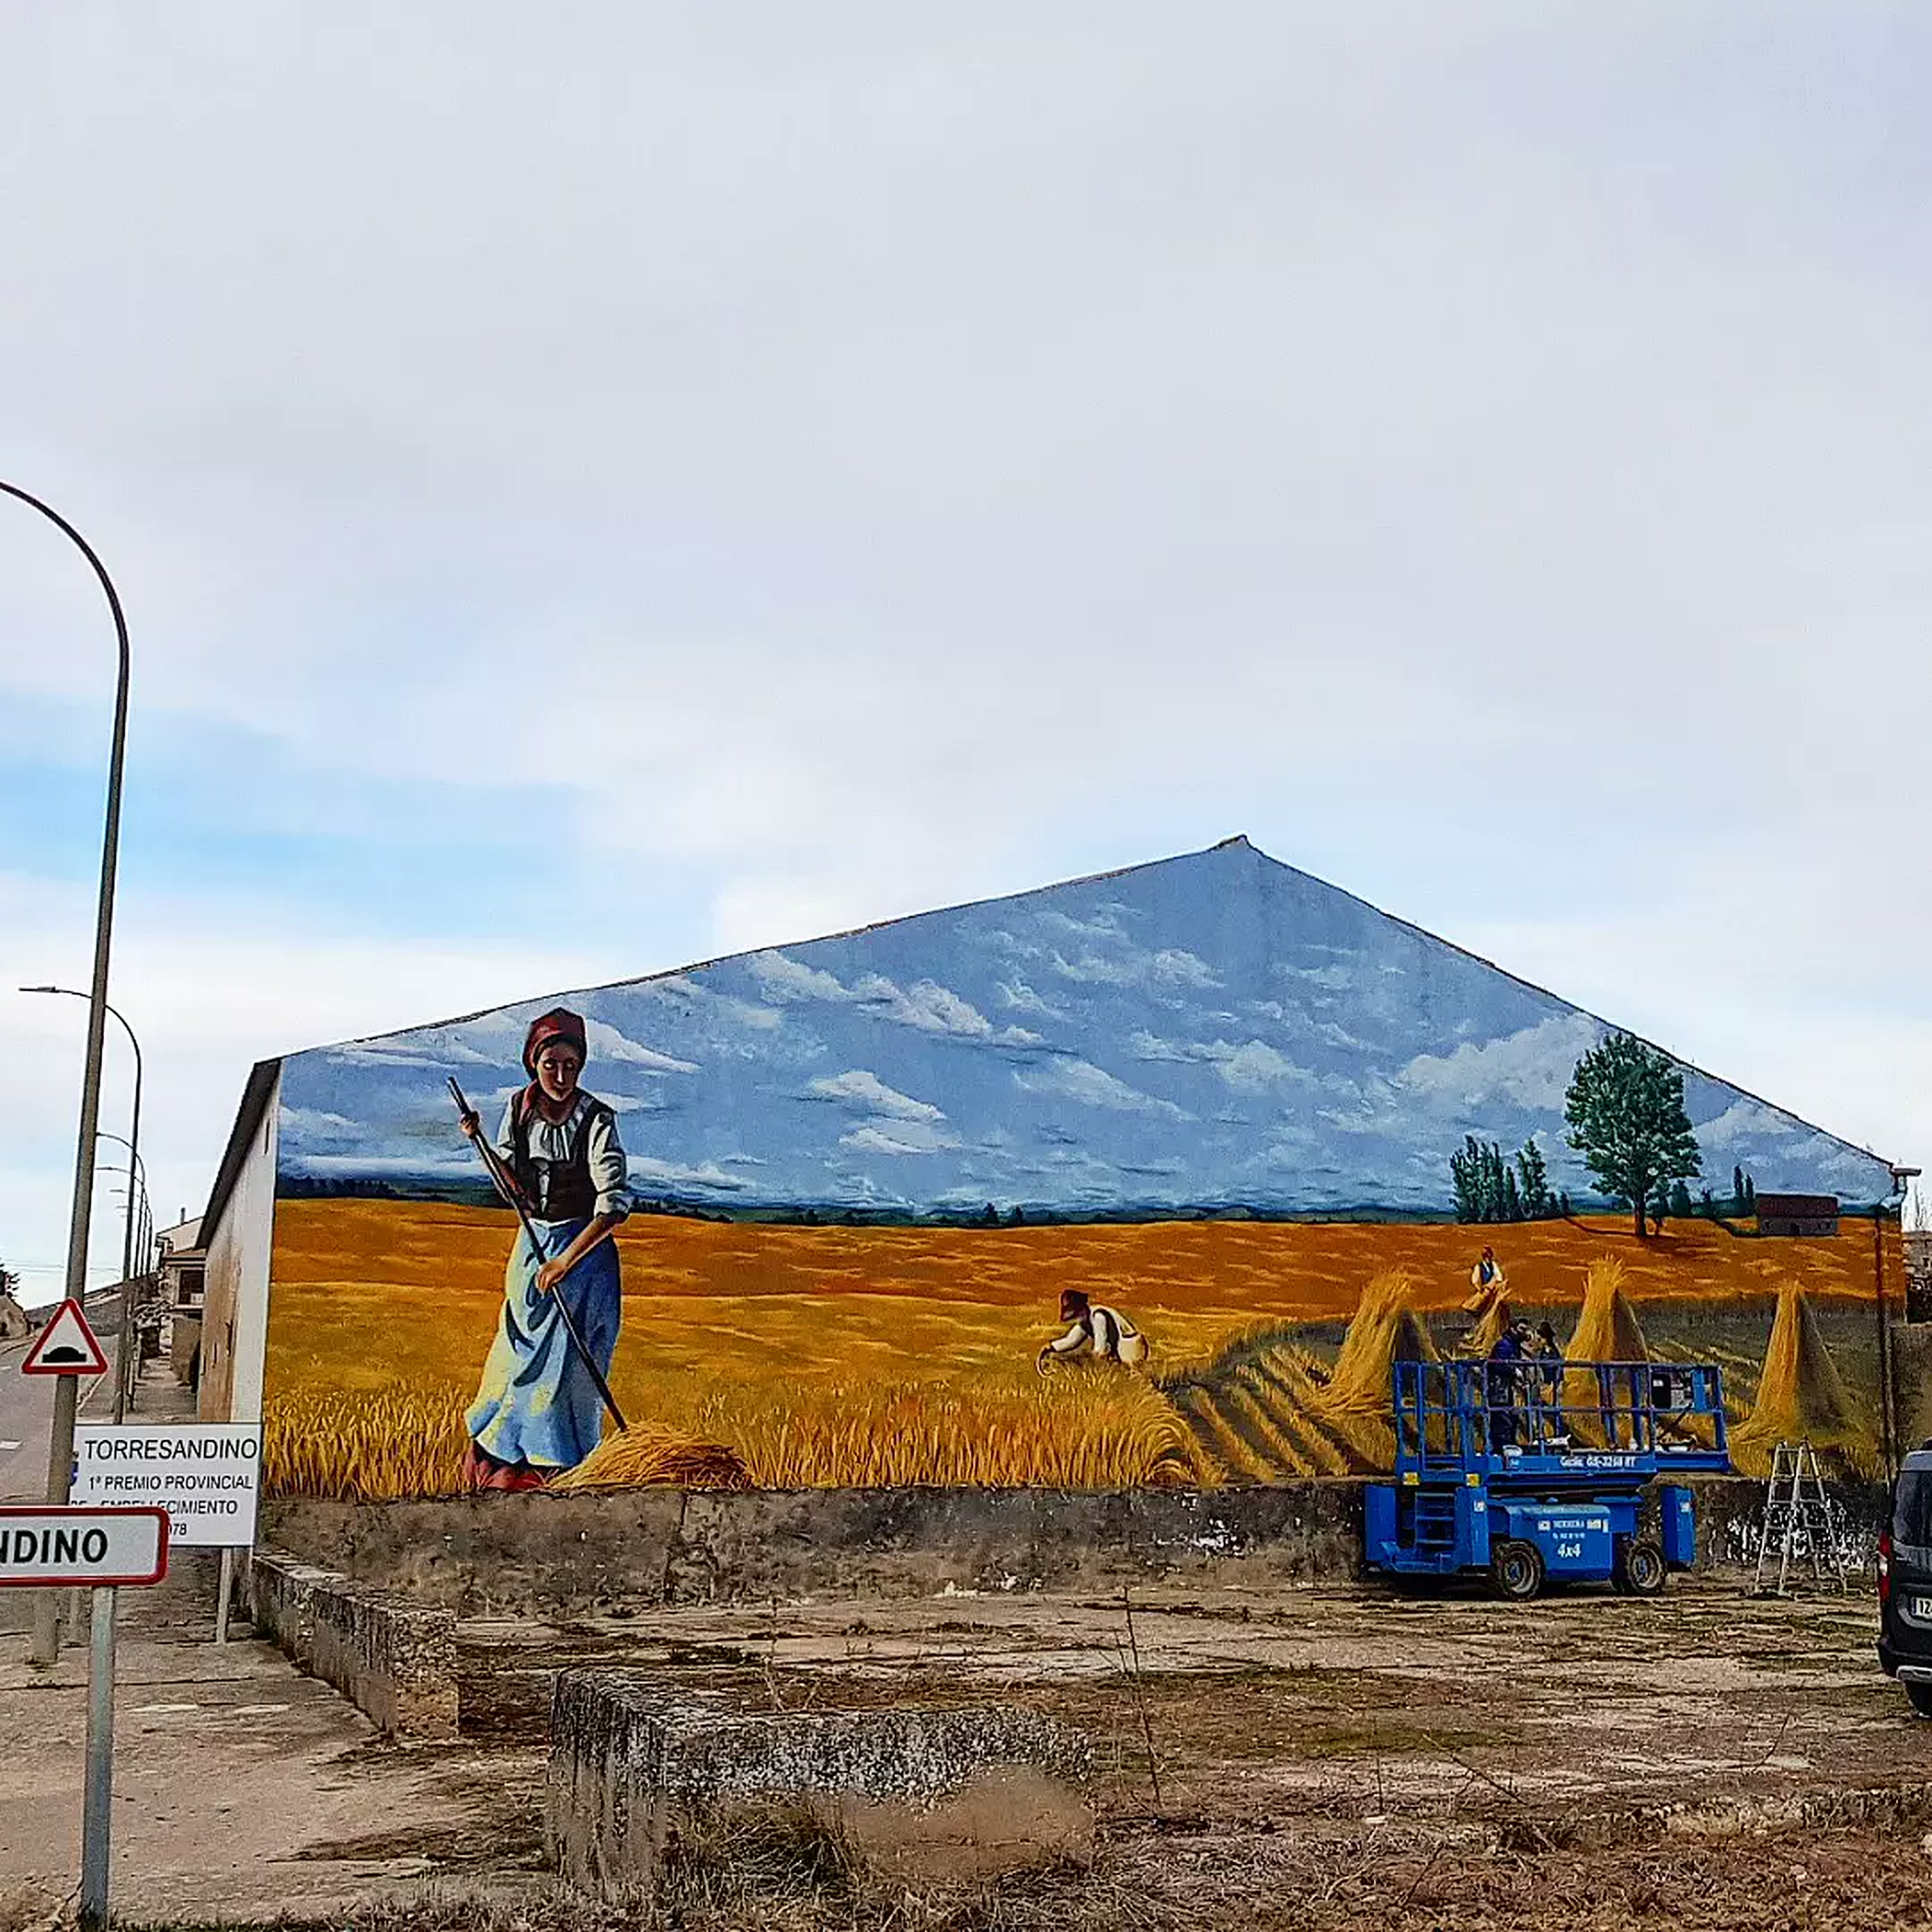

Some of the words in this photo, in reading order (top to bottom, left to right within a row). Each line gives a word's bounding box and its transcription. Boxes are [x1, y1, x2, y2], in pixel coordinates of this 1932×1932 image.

[85, 1438, 257, 1460] TORRESANDINO
[105, 1475, 162, 1491] PREMIO
[165, 1475, 253, 1490] PROVINCIAL
[169, 1522, 187, 1536] 78
[1557, 1542, 1582, 1557] 4x4
